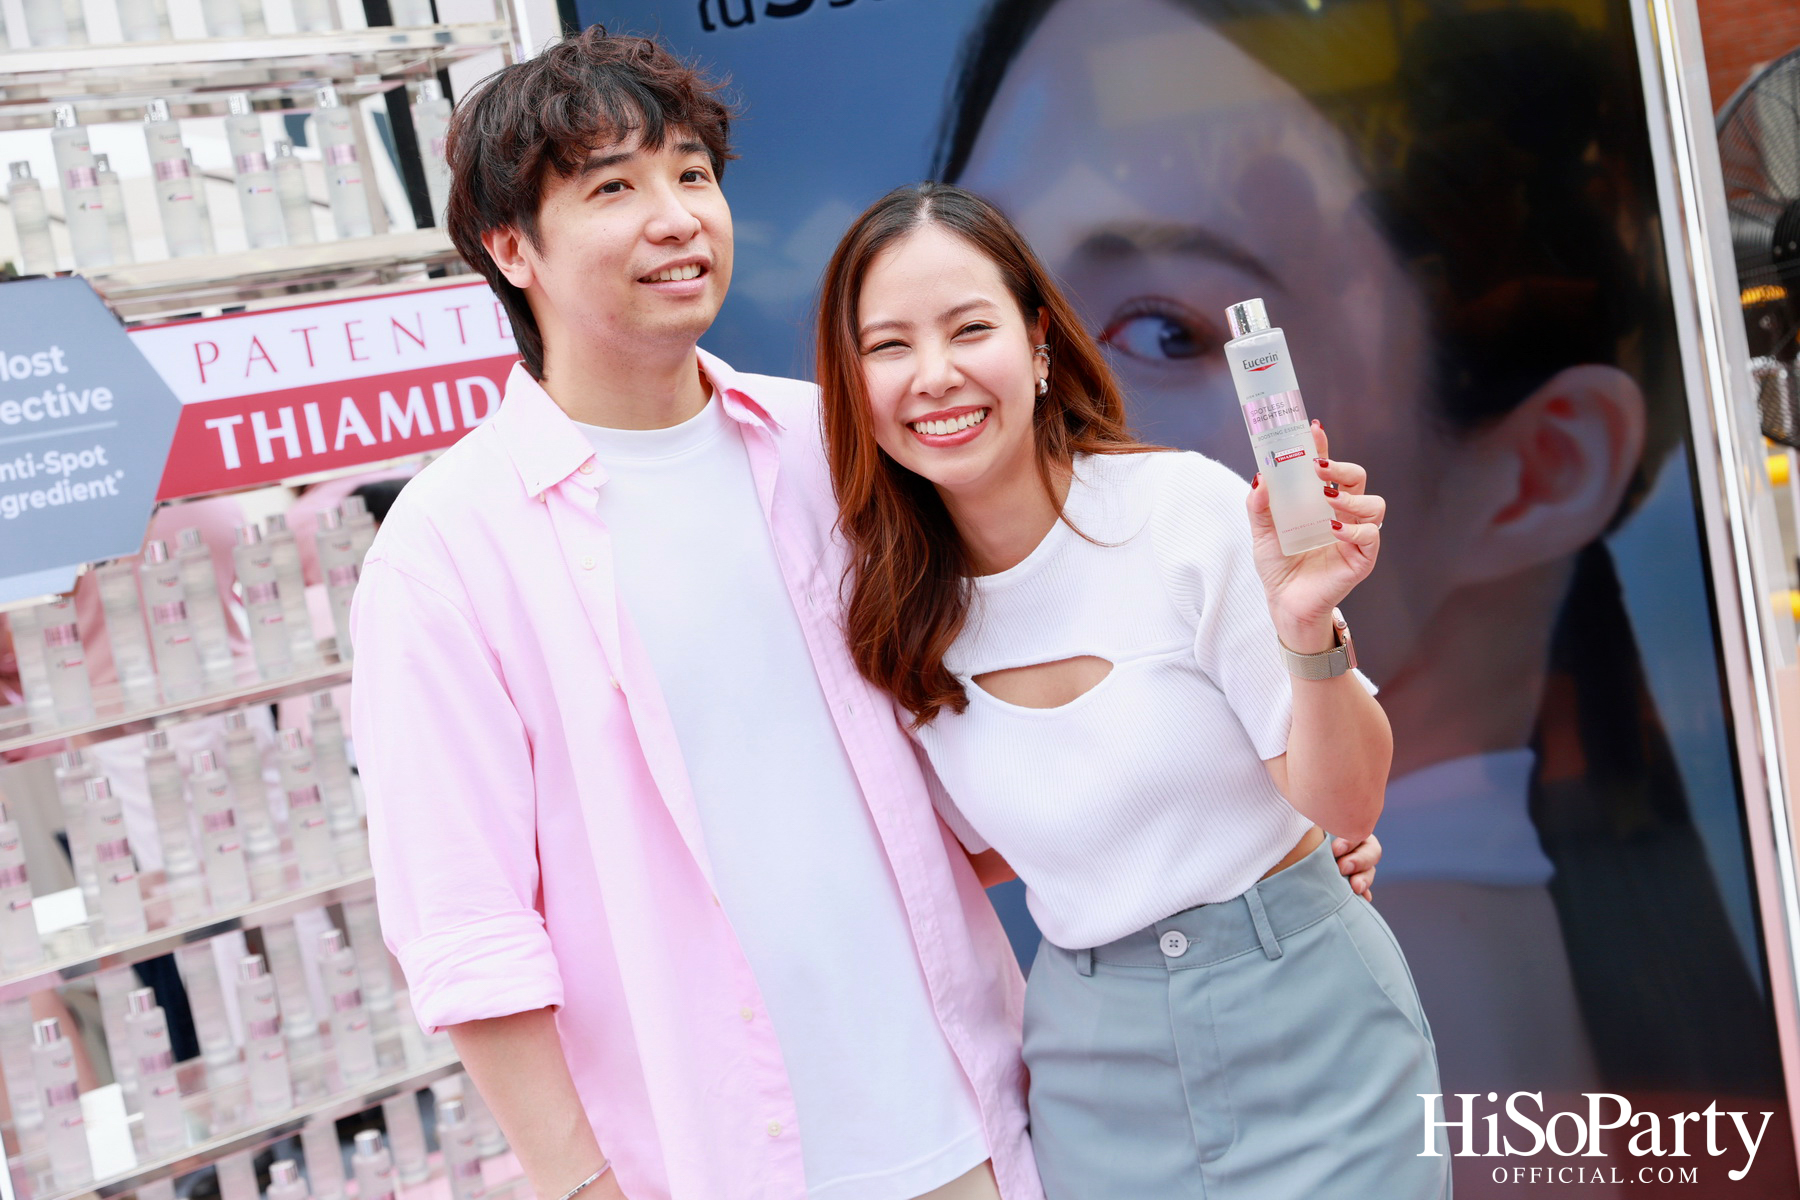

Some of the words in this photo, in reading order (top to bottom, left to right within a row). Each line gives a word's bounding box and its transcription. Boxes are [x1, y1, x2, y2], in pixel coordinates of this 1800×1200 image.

[1242, 352, 1279, 370] Eucerin
[1250, 401, 1285, 417] SPOTLESS
[1253, 405, 1300, 425] BRIGHTENING
[205, 375, 508, 470] THIAMID
[0, 469, 124, 520] gredient
